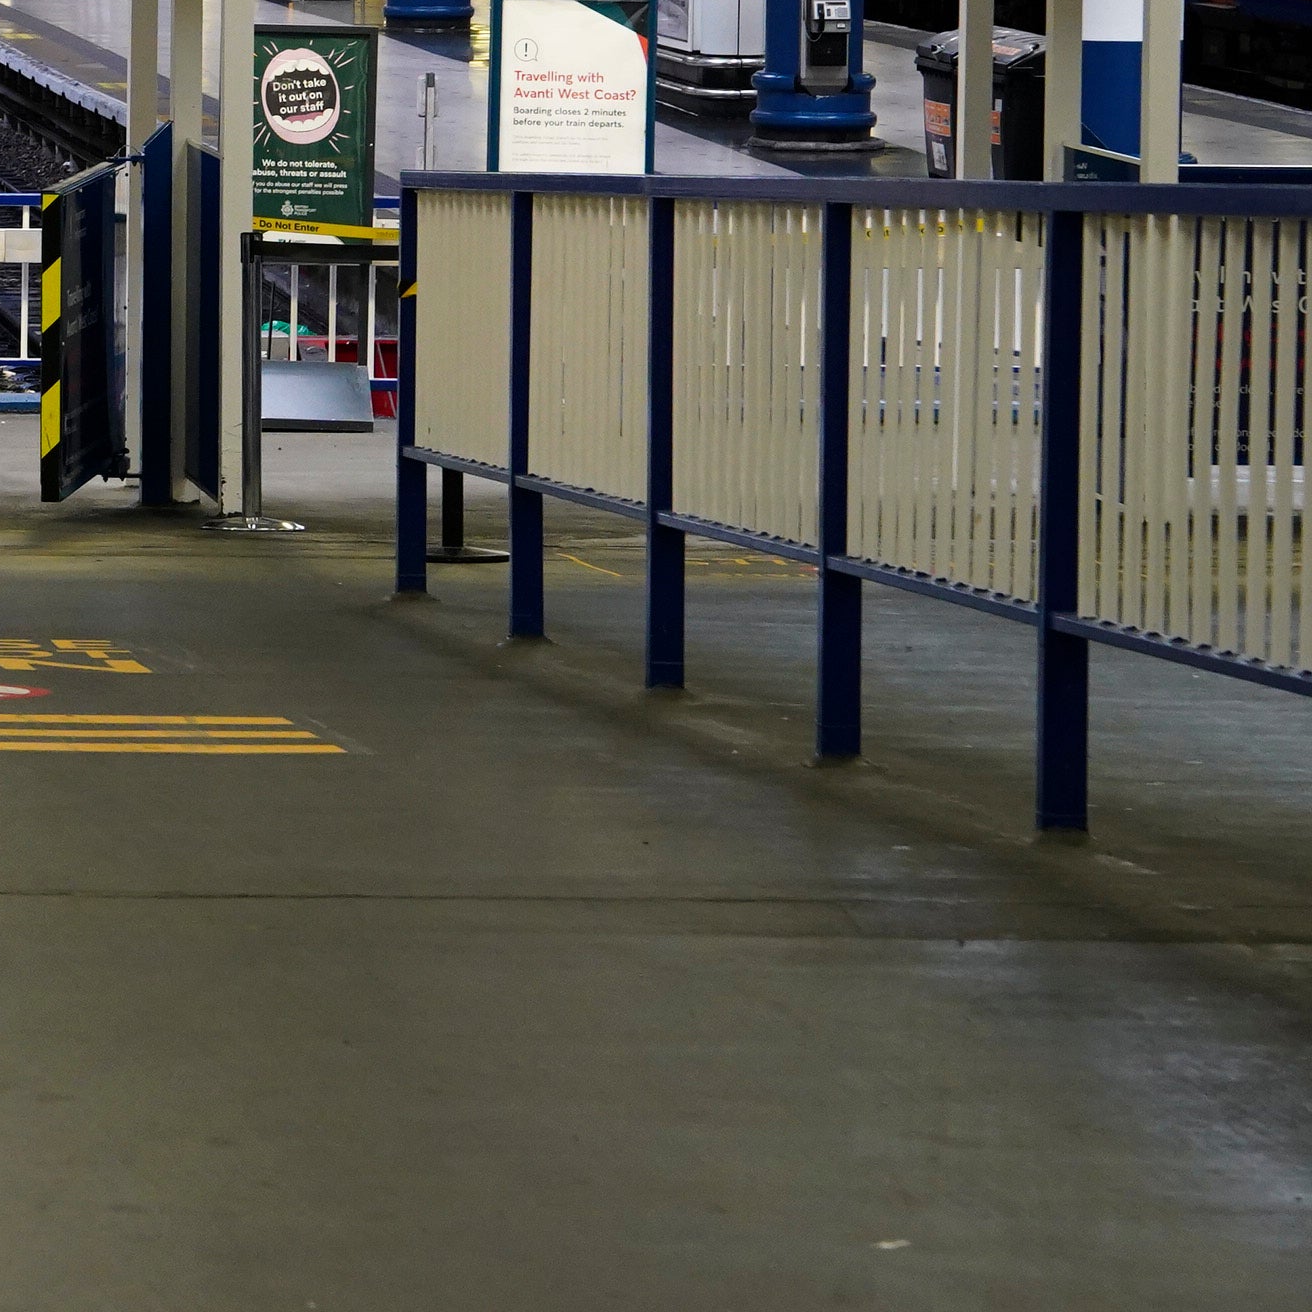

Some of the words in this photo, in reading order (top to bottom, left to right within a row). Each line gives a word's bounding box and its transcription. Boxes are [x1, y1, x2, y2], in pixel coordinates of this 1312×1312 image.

[514, 70, 573, 86] Travelling
[577, 71, 605, 84] with
[272, 79, 301, 92] Don't
[302, 77, 327, 89] take
[278, 92, 287, 103] it
[288, 91, 307, 101] out
[309, 91, 323, 100] on
[514, 87, 554, 100] Avanti
[558, 88, 590, 100] West
[594, 89, 637, 101] Coast?
[279, 105, 298, 115] our
[300, 100, 325, 112] staff
[513, 106, 552, 117] Boarding
[554, 107, 582, 117] closes
[583, 108, 589, 116] 2
[591, 108, 627, 117] minutes
[513, 117, 542, 127] before
[544, 119, 563, 128] your
[565, 119, 586, 128] train
[588, 119, 625, 129] departs.
[262, 158, 276, 167] We
[277, 159, 288, 167] do
[289, 160, 303, 168] not
[304, 159, 338, 170] tolerate,
[252, 168, 278, 177] abuse,
[279, 169, 308, 178] threats
[308, 170, 318, 178] or
[319, 170, 347, 179] assault
[259, 219, 273, 228] Do
[275, 221, 292, 230] Not
[294, 222, 320, 232] Enter
